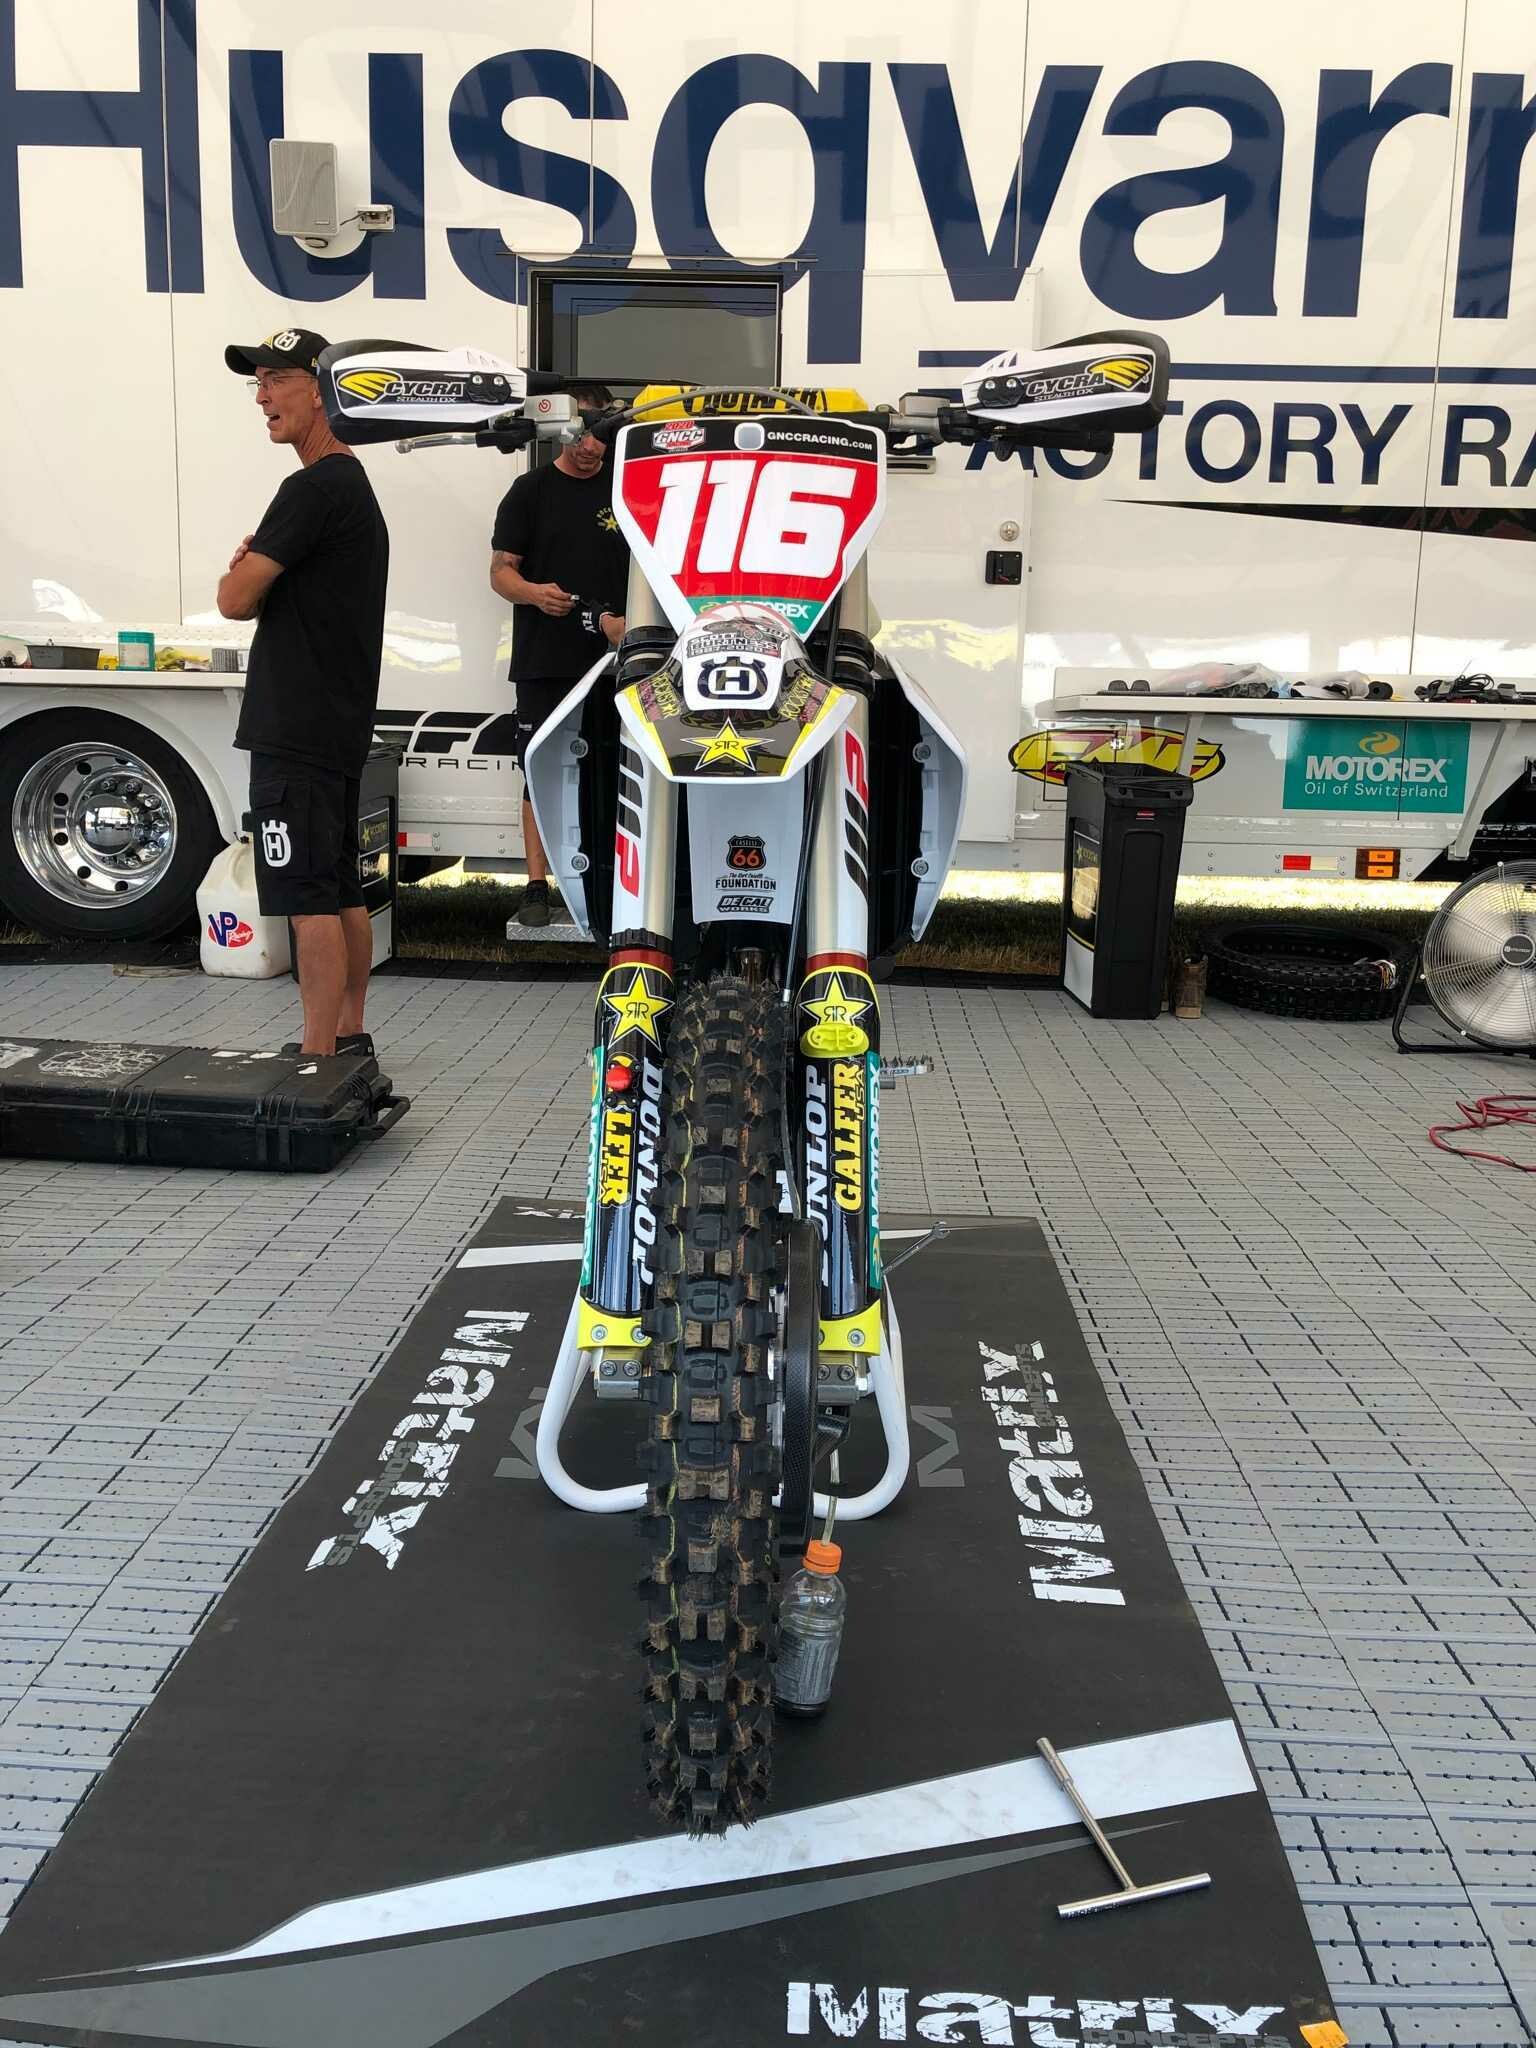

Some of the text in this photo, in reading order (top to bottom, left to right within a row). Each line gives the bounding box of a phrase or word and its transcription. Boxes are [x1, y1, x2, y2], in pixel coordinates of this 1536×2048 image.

[384, 381, 465, 397] CYCRA
[1026, 372, 1105, 397] CYCRA
[655, 429, 704, 444] GNCC
[652, 459, 857, 579] 116
[1305, 755, 1448, 783] MOTOREX
[1304, 782, 1448, 798] Oil of Switzerland
[733, 848, 760, 867] 66
[715, 879, 777, 890] FOUNDATION
[721, 896, 770, 907] DECAL
[207, 911, 238, 947] VP
[857, 1068, 866, 1121] USA
[833, 1062, 864, 1212] GALFER
[305, 1310, 531, 1571] Matrix
[978, 1340, 1126, 1606] Matrix
[786, 1981, 1286, 2048] Matrix
